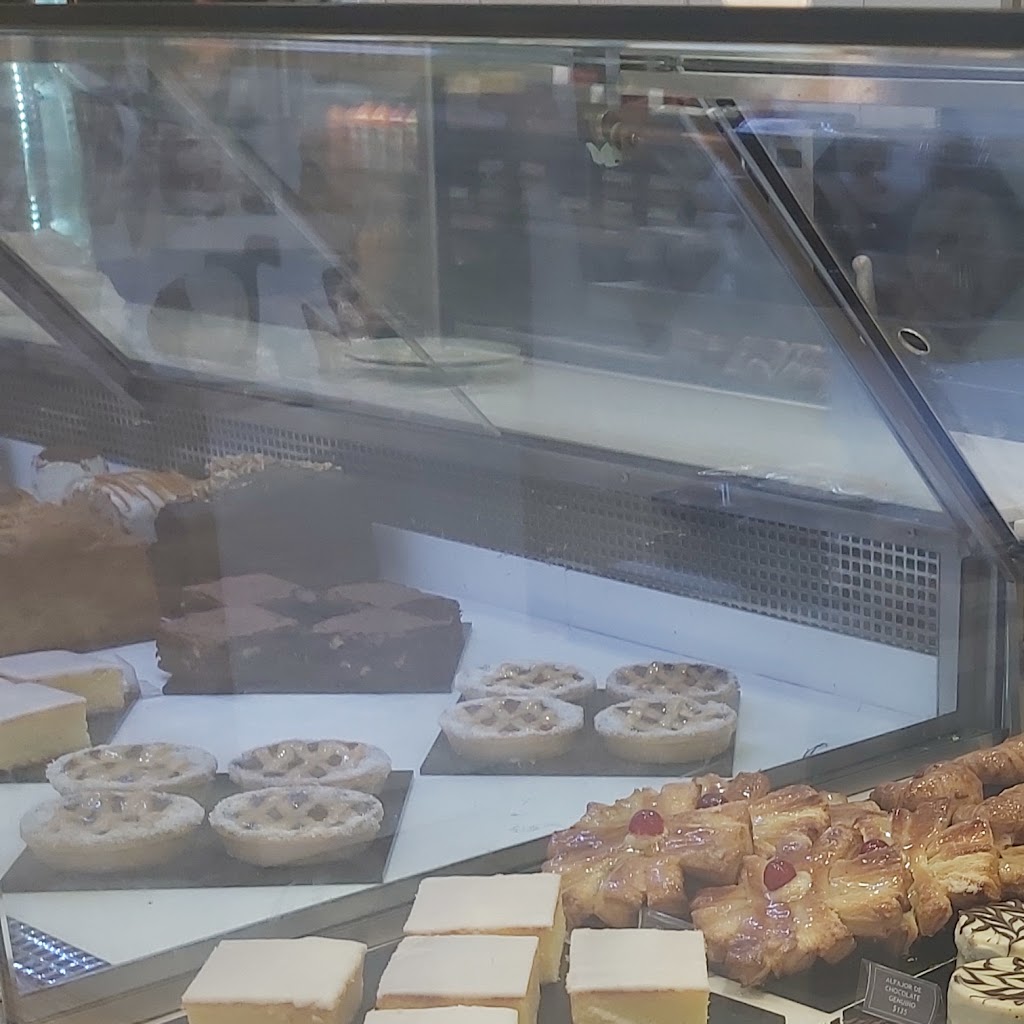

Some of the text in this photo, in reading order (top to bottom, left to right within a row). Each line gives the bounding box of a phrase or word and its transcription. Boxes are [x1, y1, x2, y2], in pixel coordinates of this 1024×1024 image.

[884, 985, 921, 1002] CHOCOLATE
[885, 977, 922, 994] ALFAJOR DE
